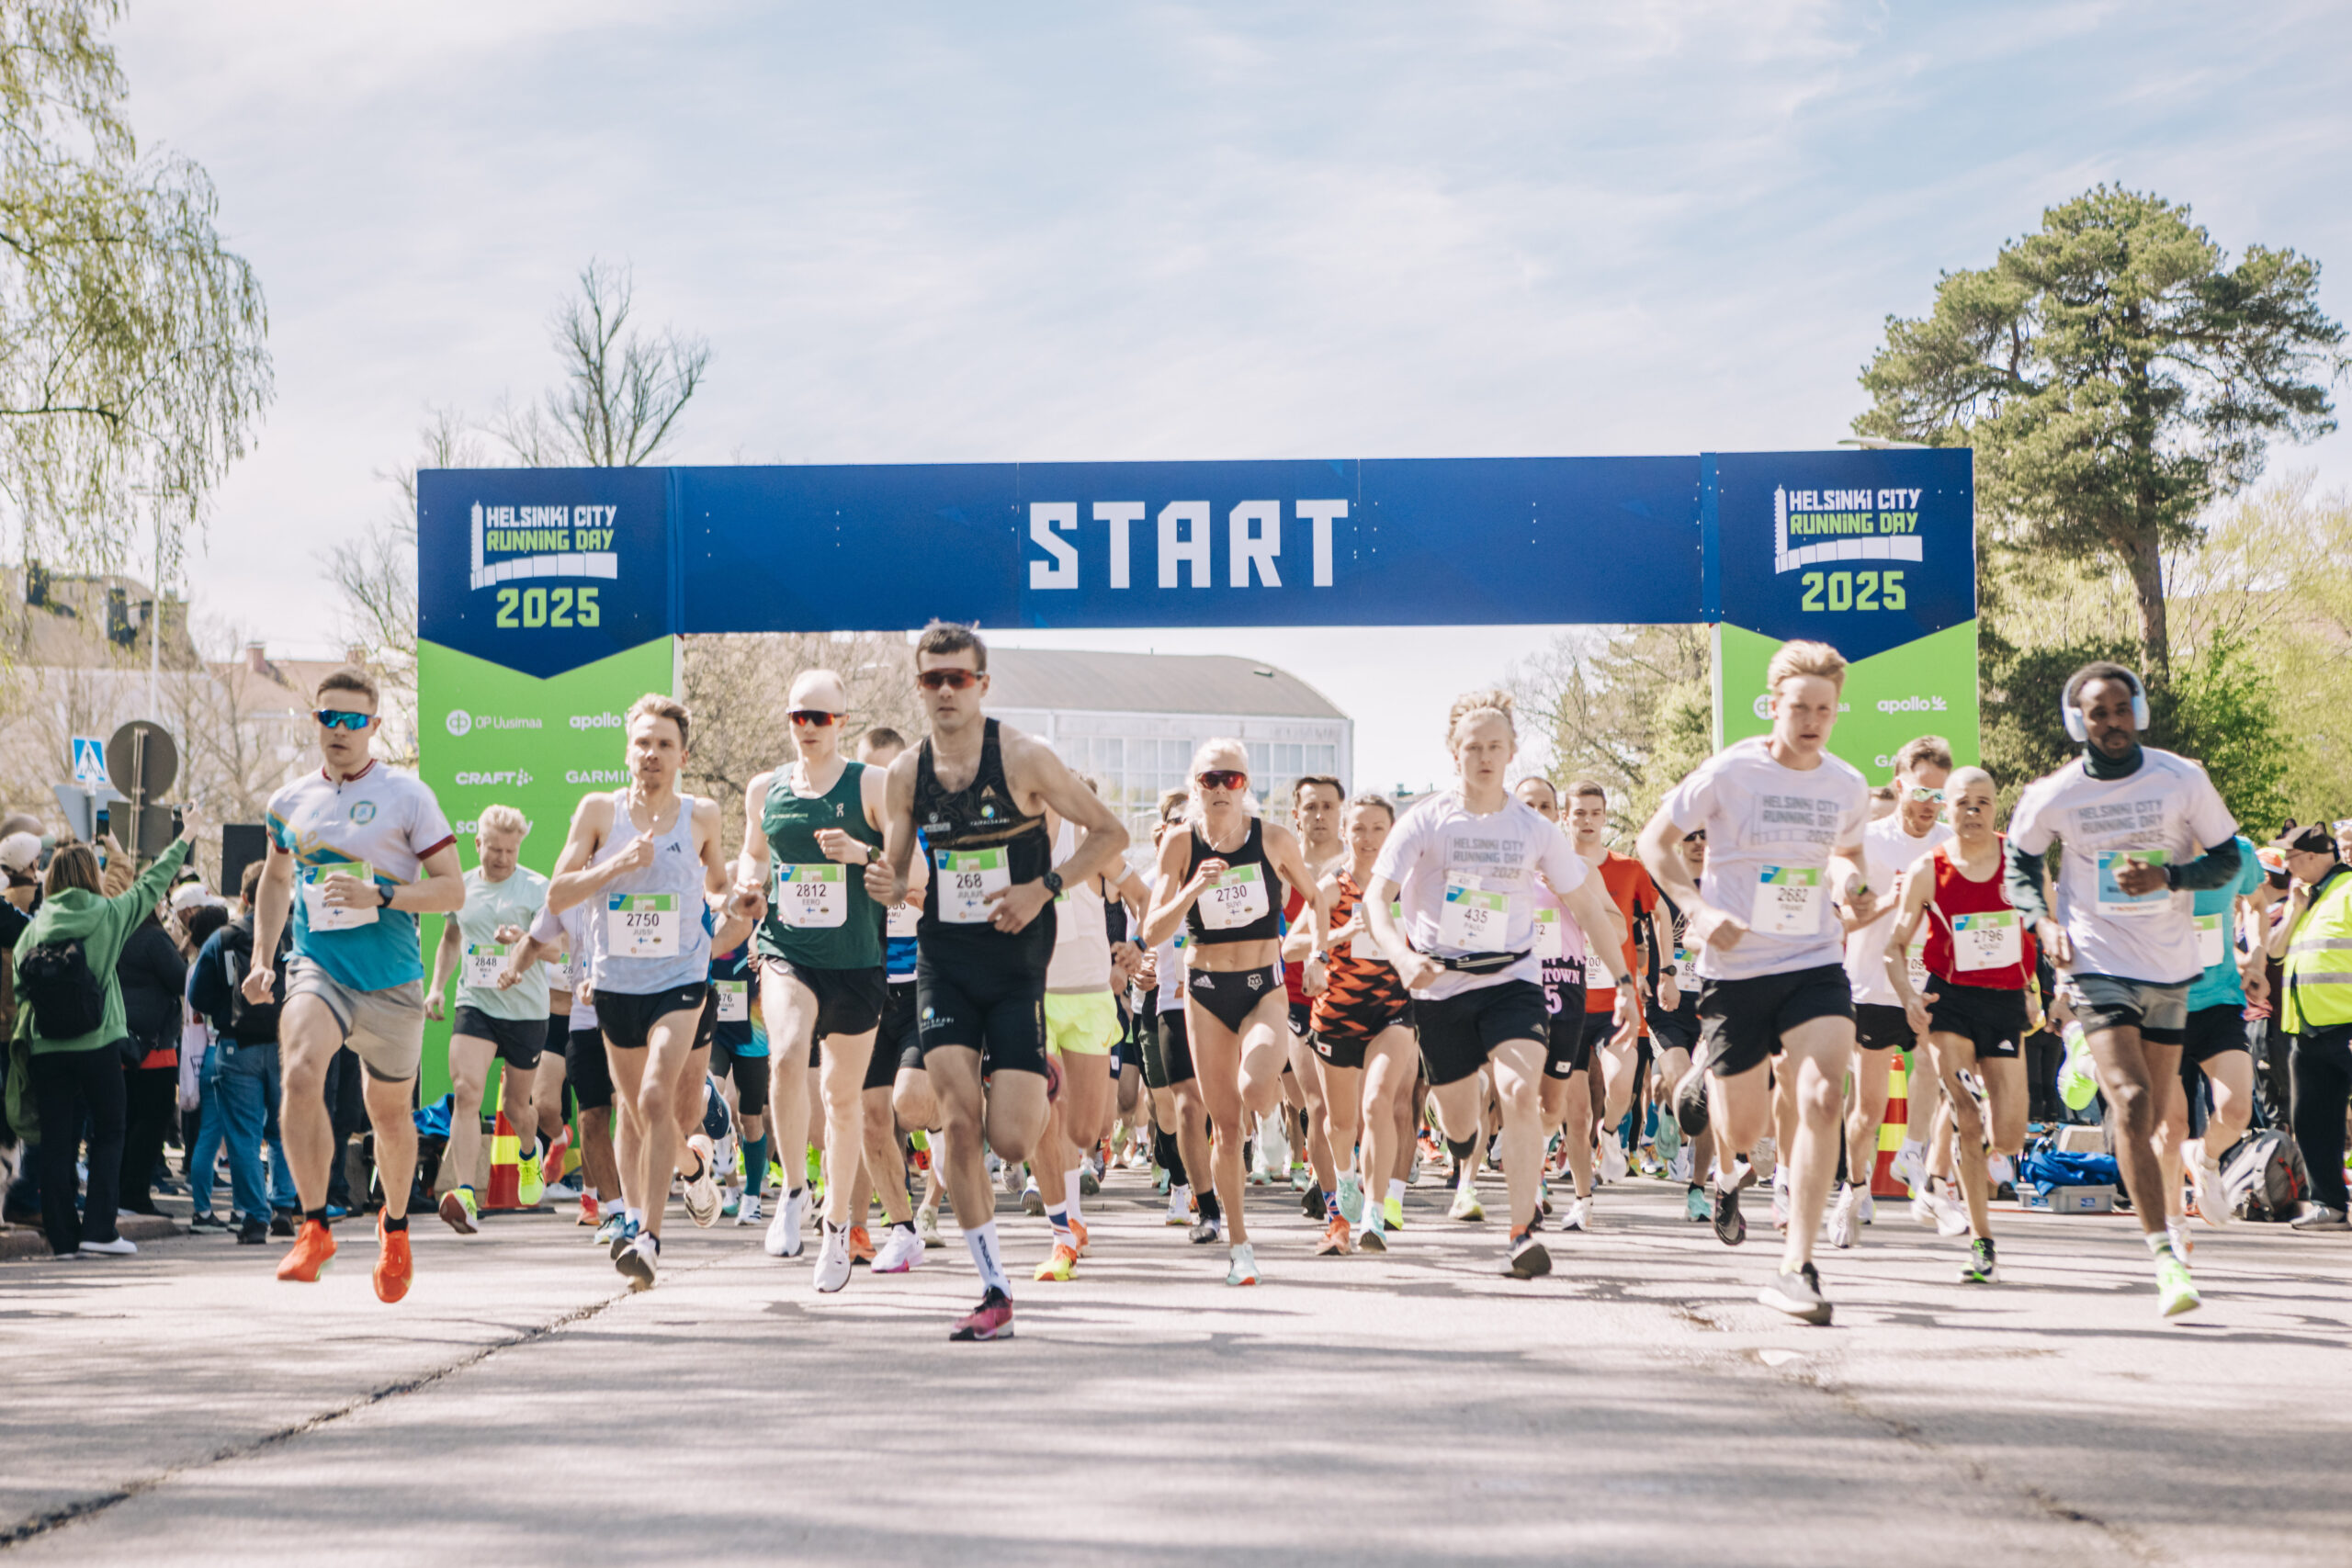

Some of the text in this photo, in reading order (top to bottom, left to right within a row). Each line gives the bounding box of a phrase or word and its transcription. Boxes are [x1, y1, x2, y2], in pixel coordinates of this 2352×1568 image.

[1790, 489, 1922, 512] HELSINKI CITY
[486, 504, 616, 528] HELSINKI CITY
[1791, 513, 1918, 535] RUNNING DAY
[486, 529, 615, 551] RUNNING DAY
[1030, 499, 1349, 590] START
[1802, 570, 1905, 612] 2025
[496, 587, 600, 628] 2025
[1877, 696, 1929, 715] apollo
[475, 716, 543, 729] OP Uusimaa
[569, 712, 622, 731] apollo
[456, 772, 516, 785] CRAFT
[956, 873, 983, 889] 268
[796, 884, 827, 897] 2812
[1216, 885, 1248, 903] 2730
[627, 913, 660, 927] 2750
[1464, 908, 1488, 924] 435
[1973, 929, 2004, 943] 2796
[475, 957, 497, 967] 2848
